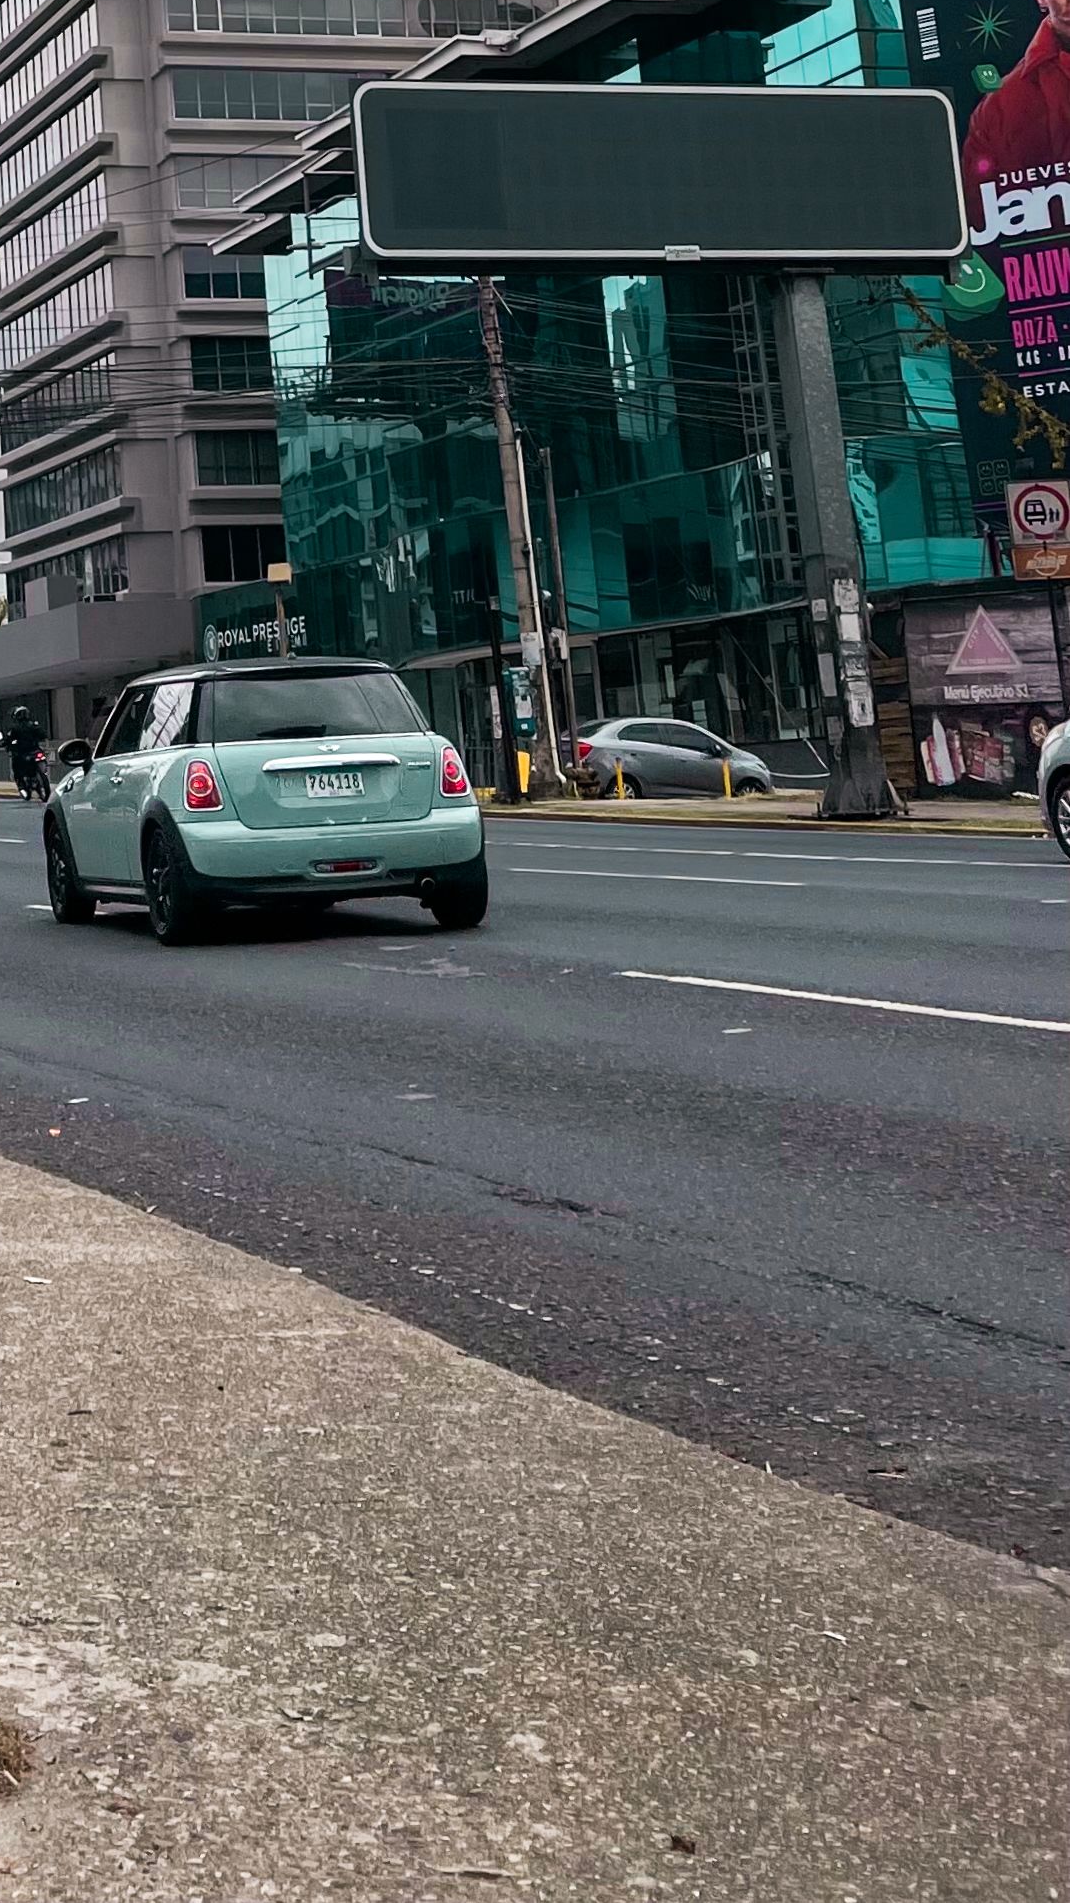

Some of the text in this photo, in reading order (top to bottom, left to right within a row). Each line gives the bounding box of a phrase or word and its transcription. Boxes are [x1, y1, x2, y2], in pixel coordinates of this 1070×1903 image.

[999, 162, 1070, 186] JUEVE
[1012, 315, 1058, 348] BOZA
[1023, 380, 1070, 398] ESTA
[218, 626, 251, 648] ROYAL
[252, 615, 306, 641] PRESIGE
